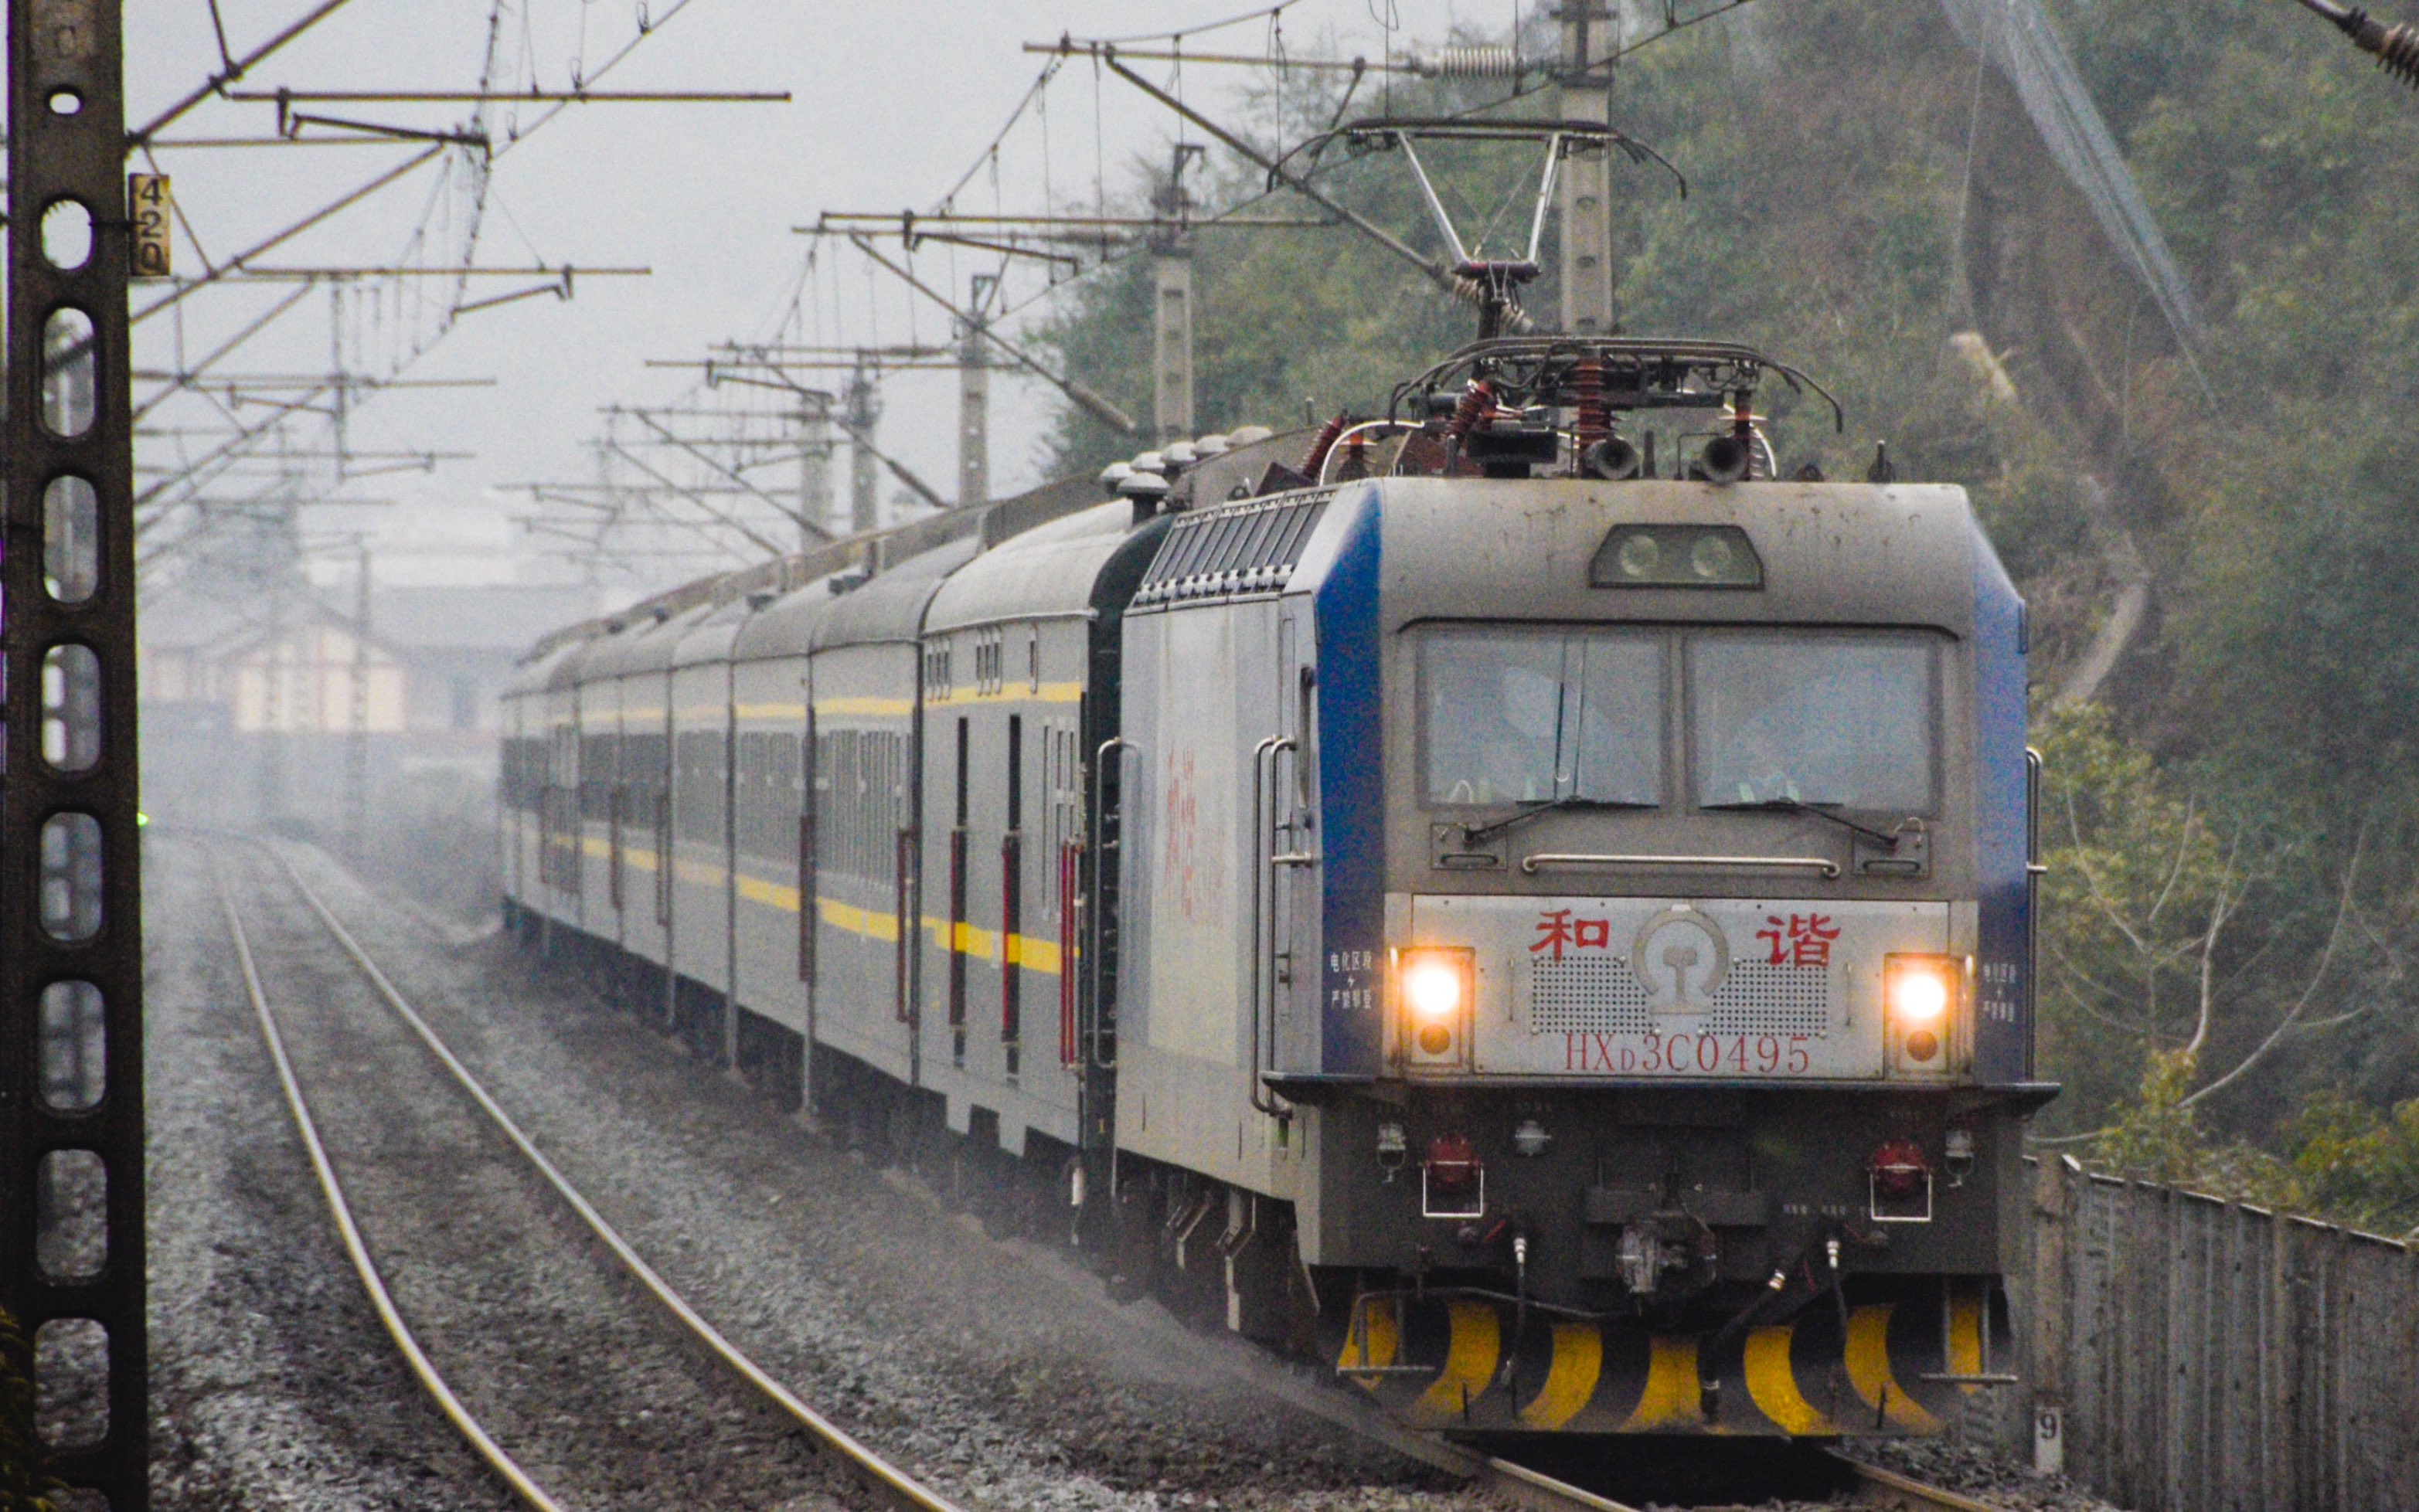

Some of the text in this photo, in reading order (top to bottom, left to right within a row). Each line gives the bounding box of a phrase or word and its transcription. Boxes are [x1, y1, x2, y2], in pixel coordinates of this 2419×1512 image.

[141, 178, 162, 270] 420
[1529, 908, 1841, 967] 和 谐
[1565, 1032, 1810, 1073] HXD3C0495
[2040, 1412, 2057, 1439] 9
